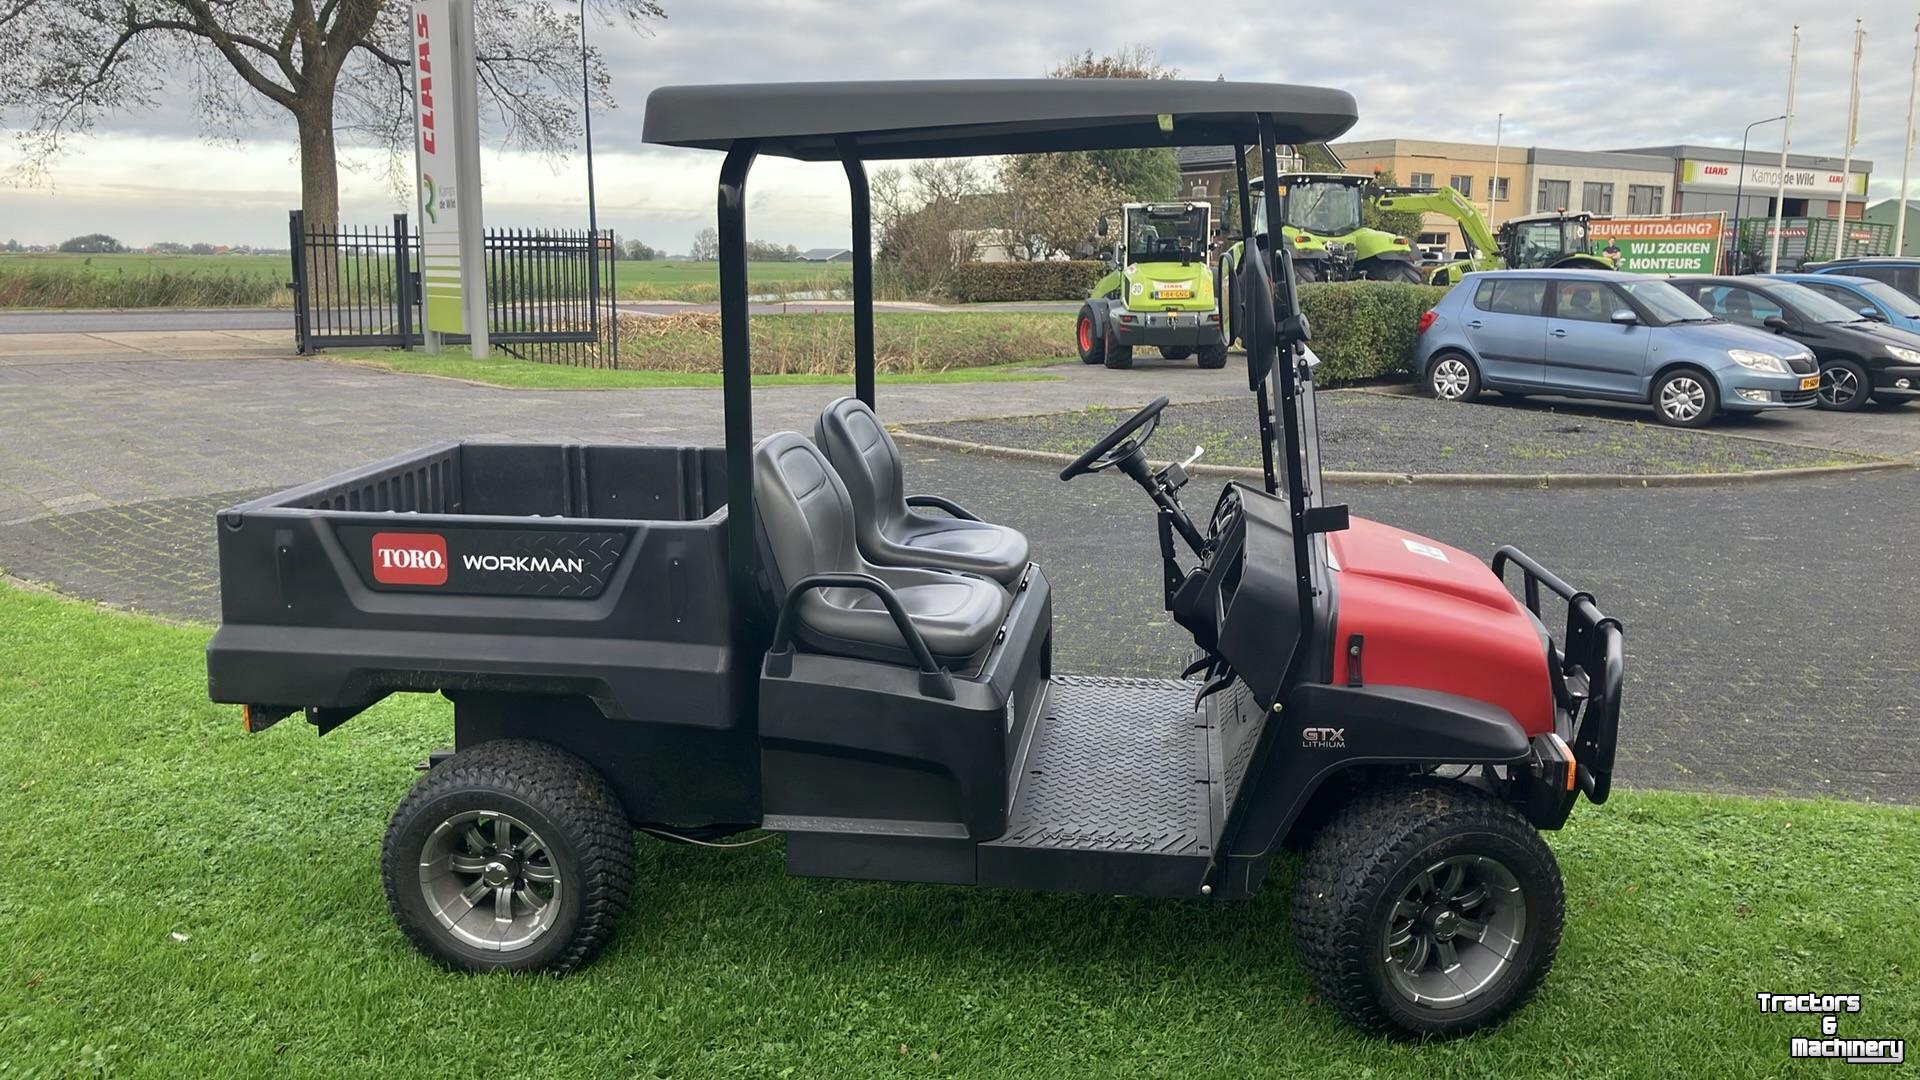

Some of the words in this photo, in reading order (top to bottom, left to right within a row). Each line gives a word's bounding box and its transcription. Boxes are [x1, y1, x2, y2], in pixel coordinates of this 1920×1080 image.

[417, 13, 436, 154] CLAAS
[1704, 166, 1729, 176] CLAAS
[1783, 172, 1794, 185] de
[1796, 172, 1816, 186] Wild
[1634, 223, 1712, 236] UITDAGING?
[1631, 242, 1656, 255] WIJ
[1657, 242, 1711, 255] ZOEKEN
[1629, 258, 1702, 270] MONTEURS
[462, 554, 584, 574] WORKMAN
[1303, 728, 1344, 741] GTX
